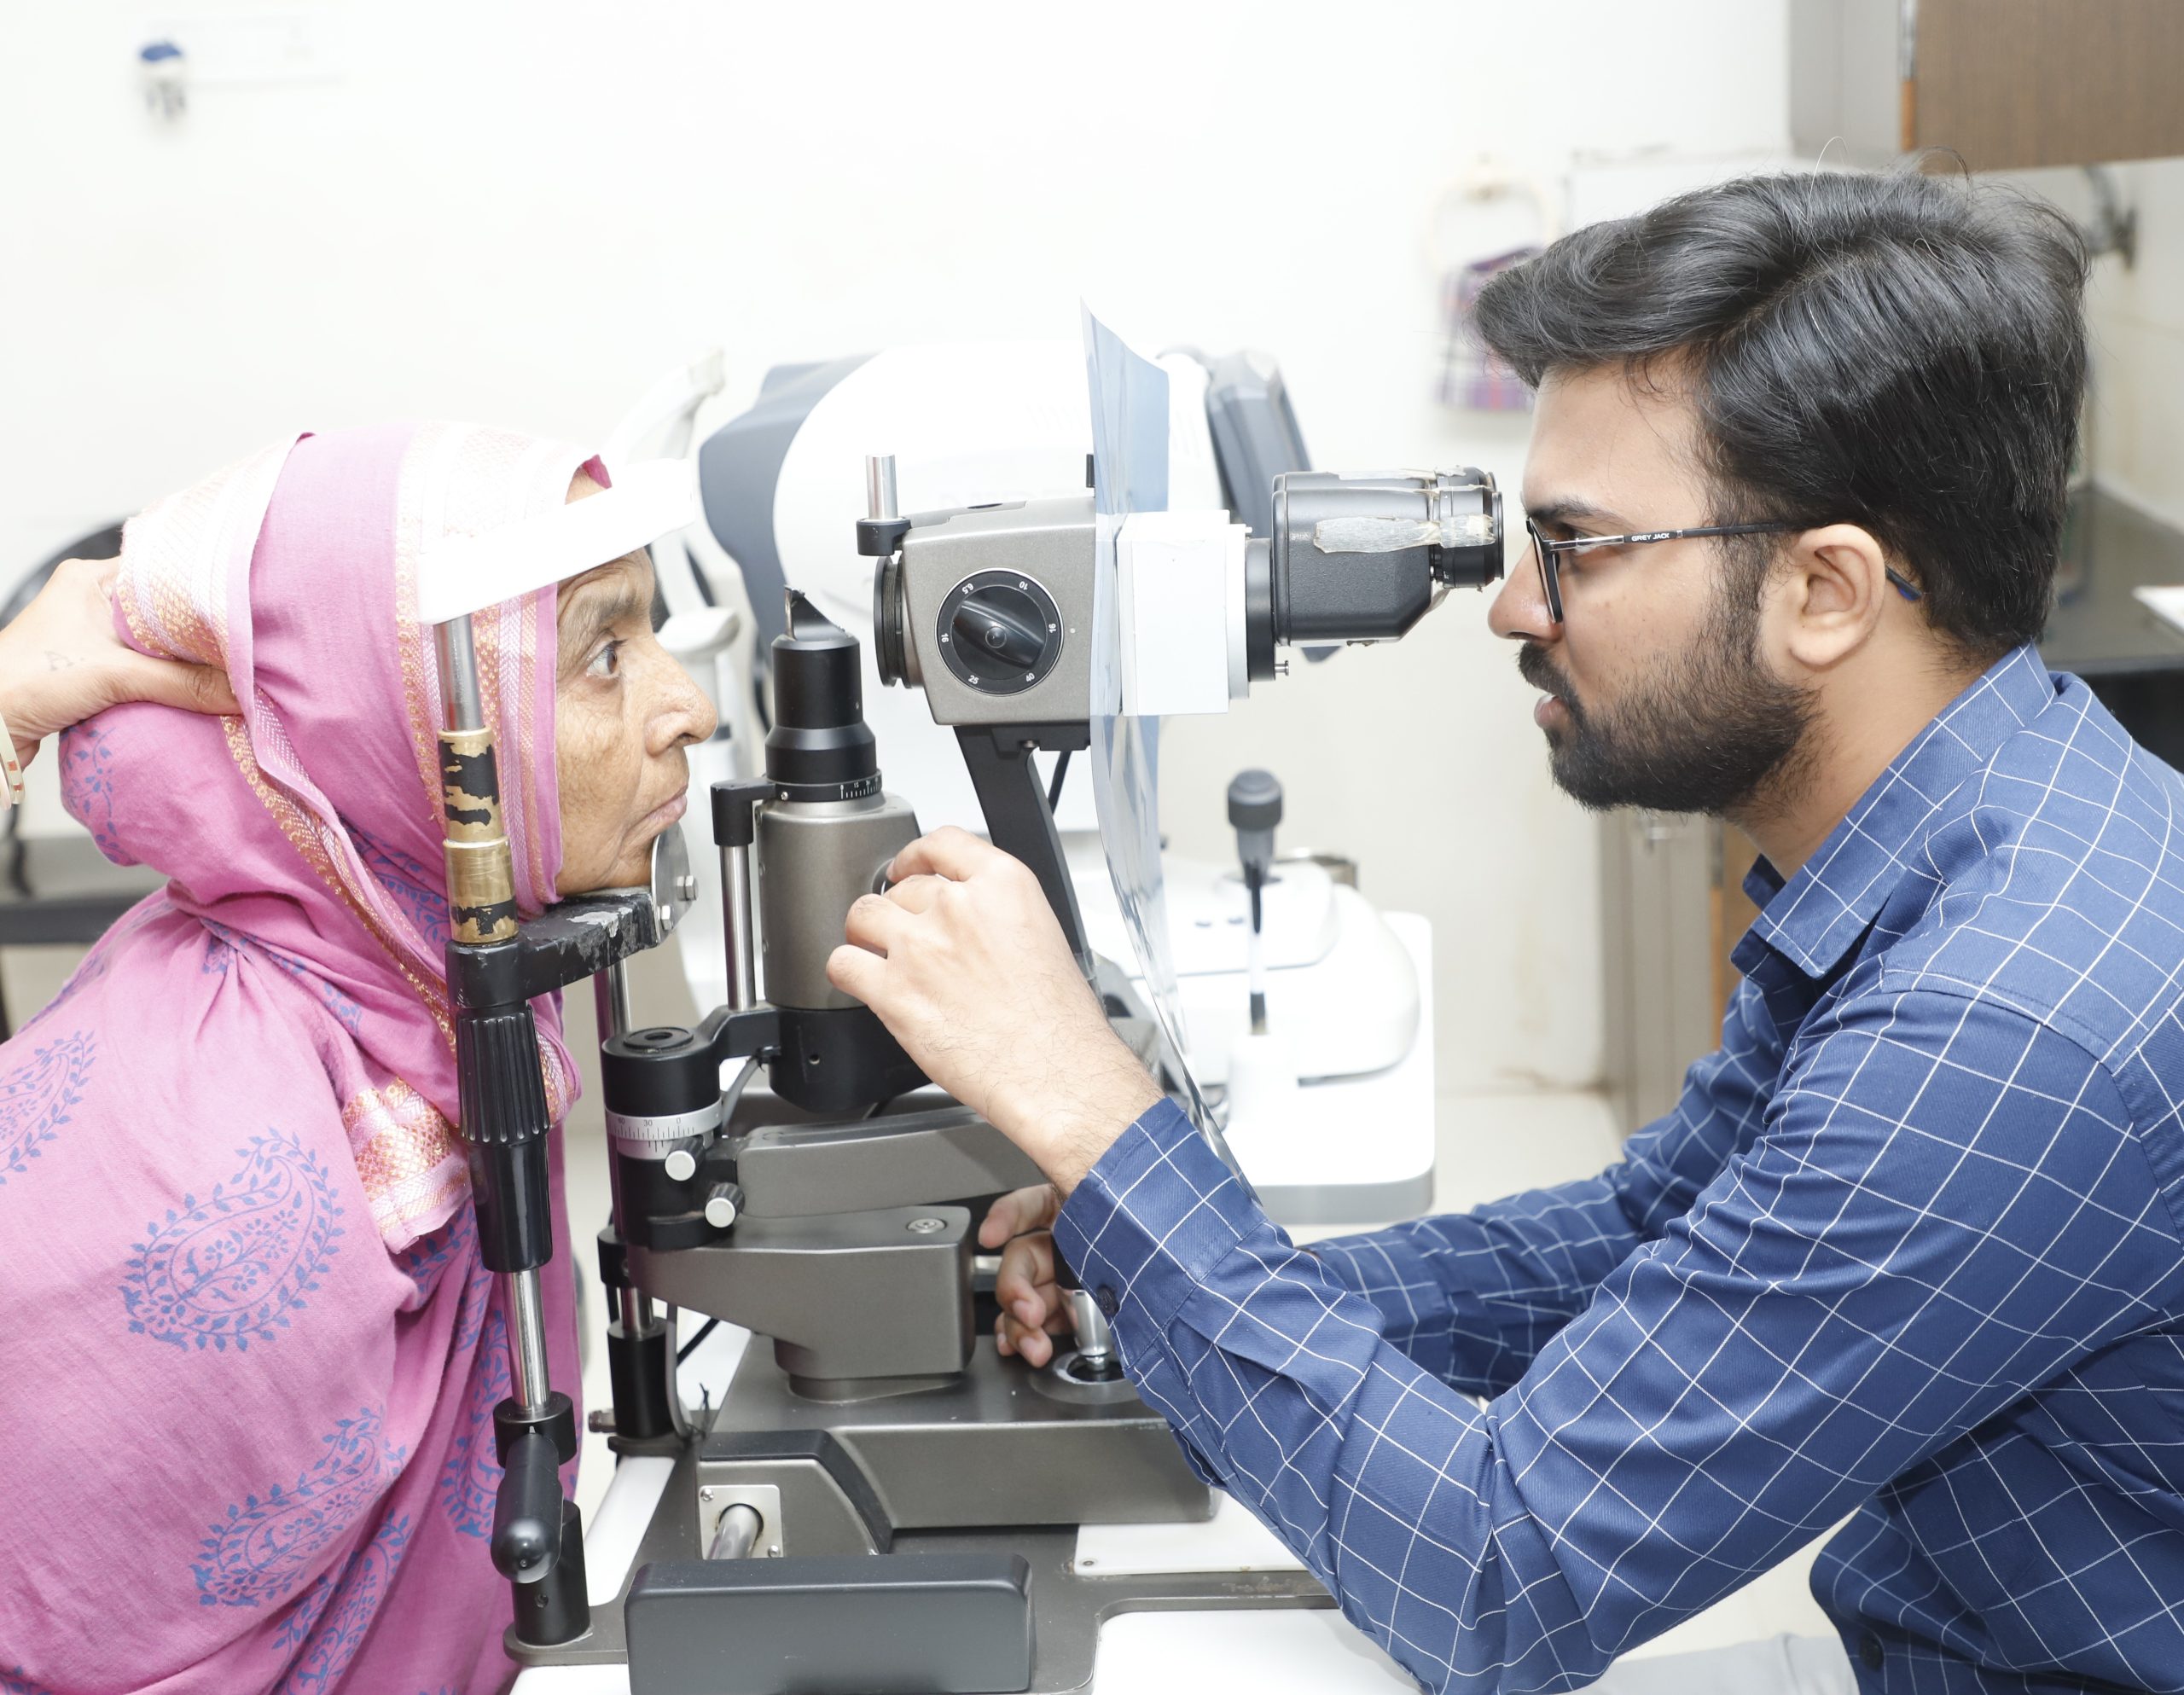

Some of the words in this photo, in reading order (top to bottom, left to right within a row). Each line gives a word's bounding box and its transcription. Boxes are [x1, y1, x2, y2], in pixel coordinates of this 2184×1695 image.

[961, 583, 974, 595] 6.5
[1019, 581, 1029, 590] 10
[1048, 623, 1057, 634] 16
[940, 633, 949, 643] 16
[967, 675, 979, 685] 25
[1025, 672, 1036, 682] 40
